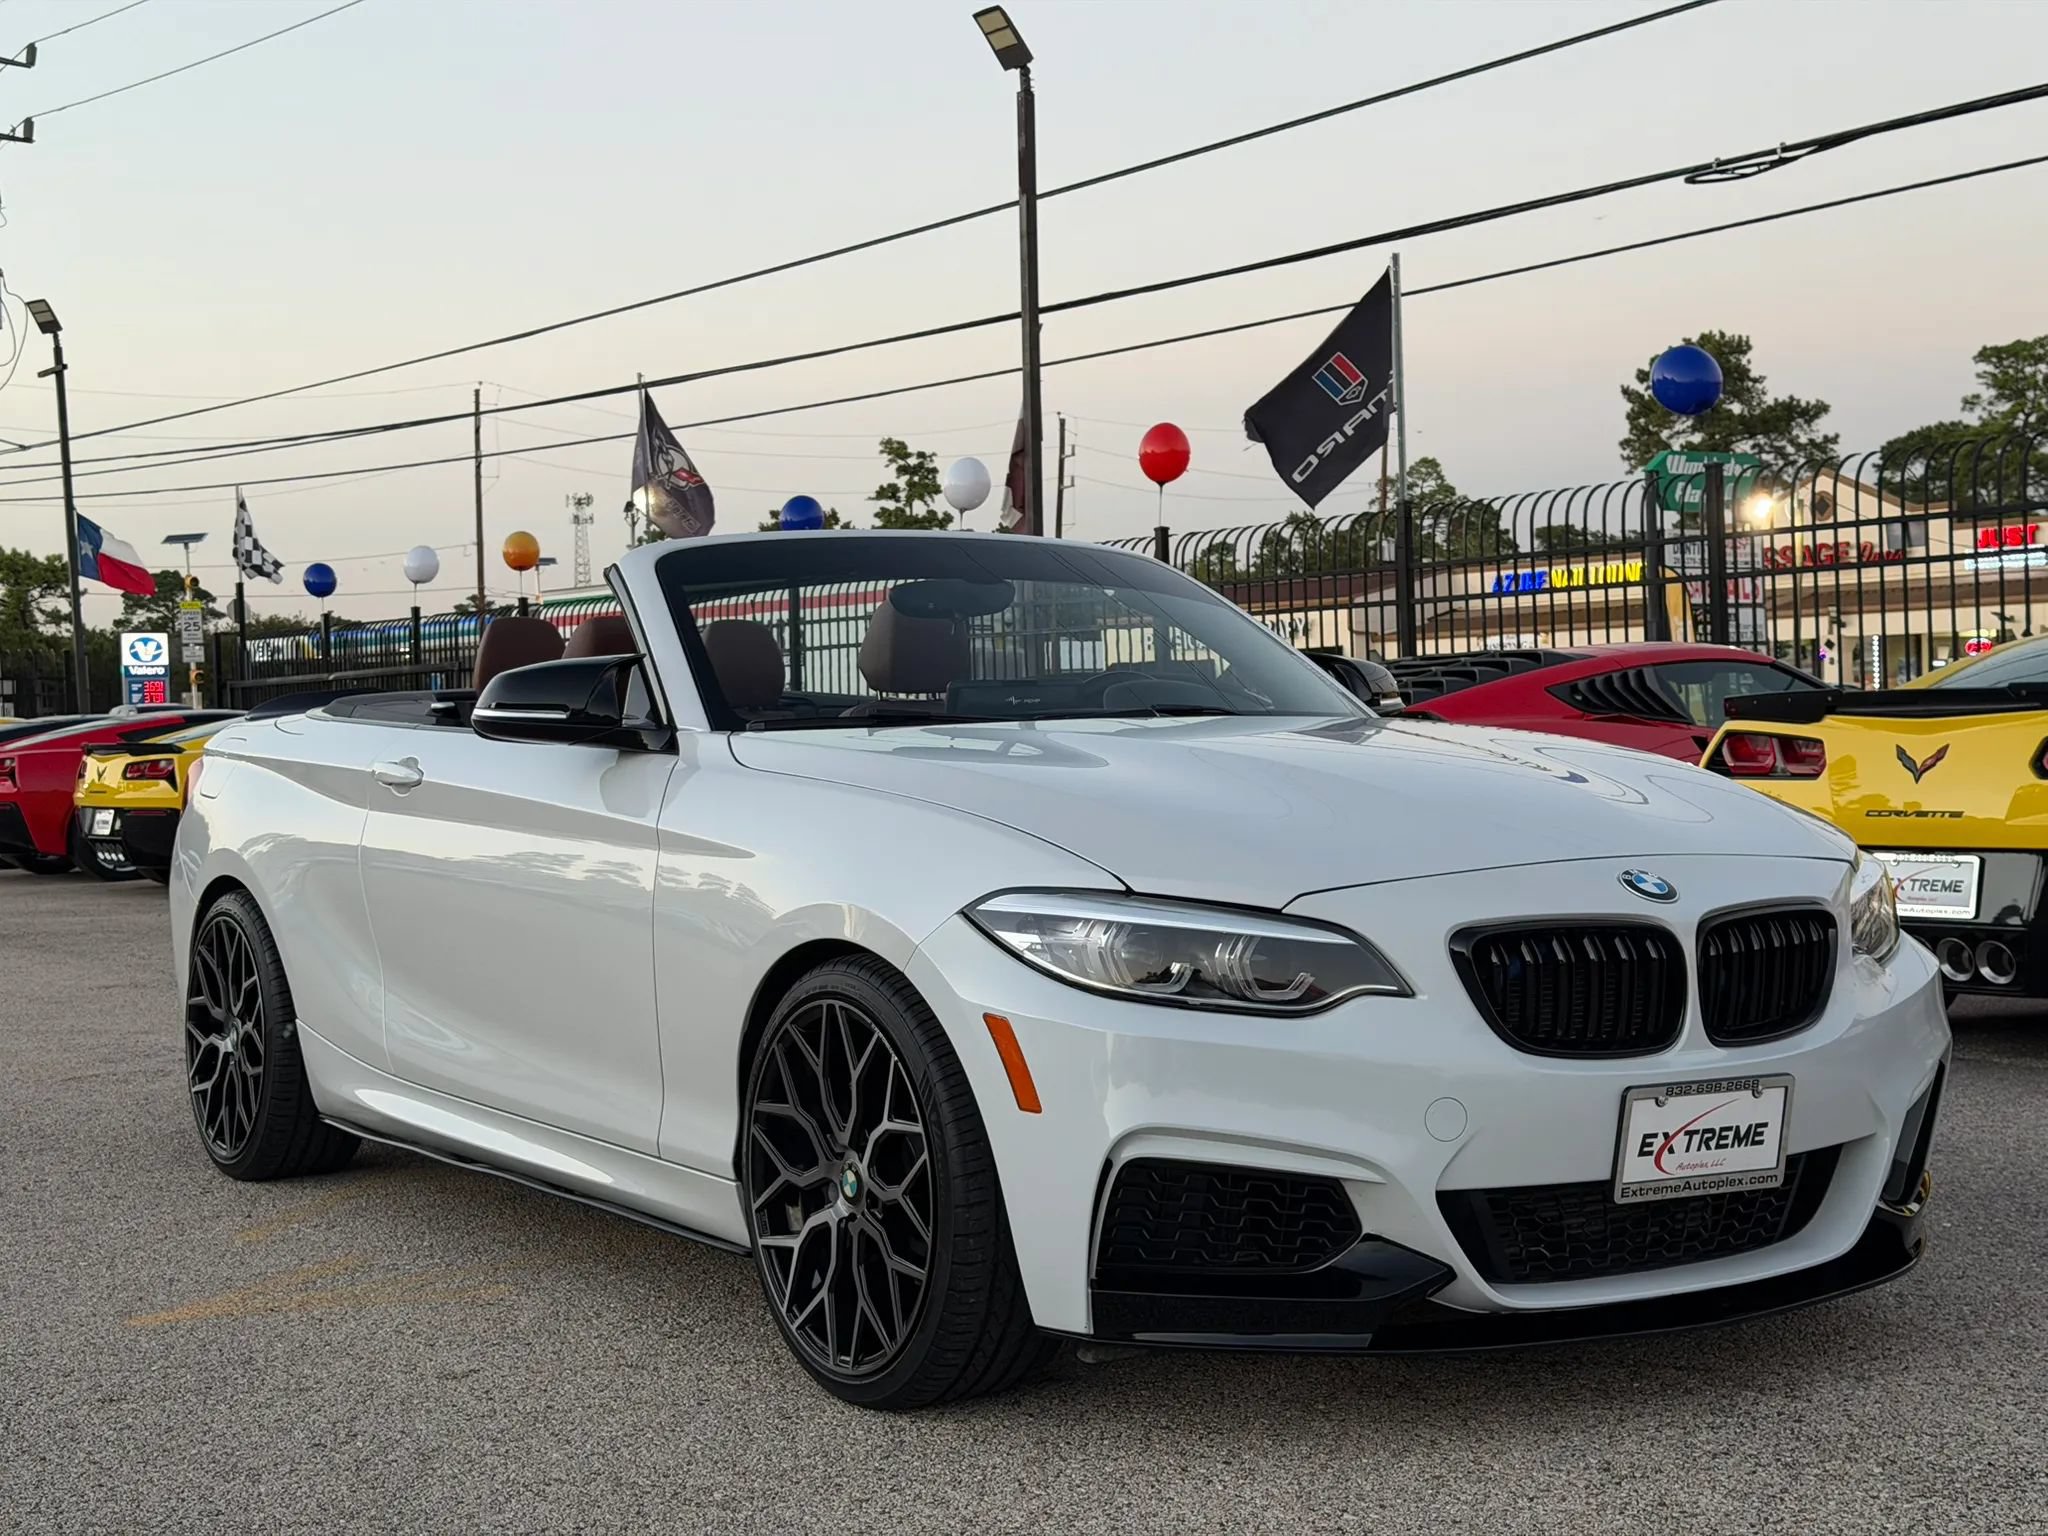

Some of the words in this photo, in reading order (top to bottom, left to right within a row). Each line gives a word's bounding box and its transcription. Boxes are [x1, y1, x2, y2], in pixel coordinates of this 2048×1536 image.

[1674, 481, 1735, 503] Pla
[1977, 523, 2039, 549] JUST
[1763, 541, 1850, 570] SSAGE
[183, 621, 201, 632] 25
[128, 665, 165, 676] Valero
[1865, 810, 1965, 818] CORVETTE
[1636, 1121, 1769, 1160] EXTREME
[1711, 1157, 1727, 1167] LLC
[1620, 1173, 1779, 1200] ExtremeAutoplex.com
